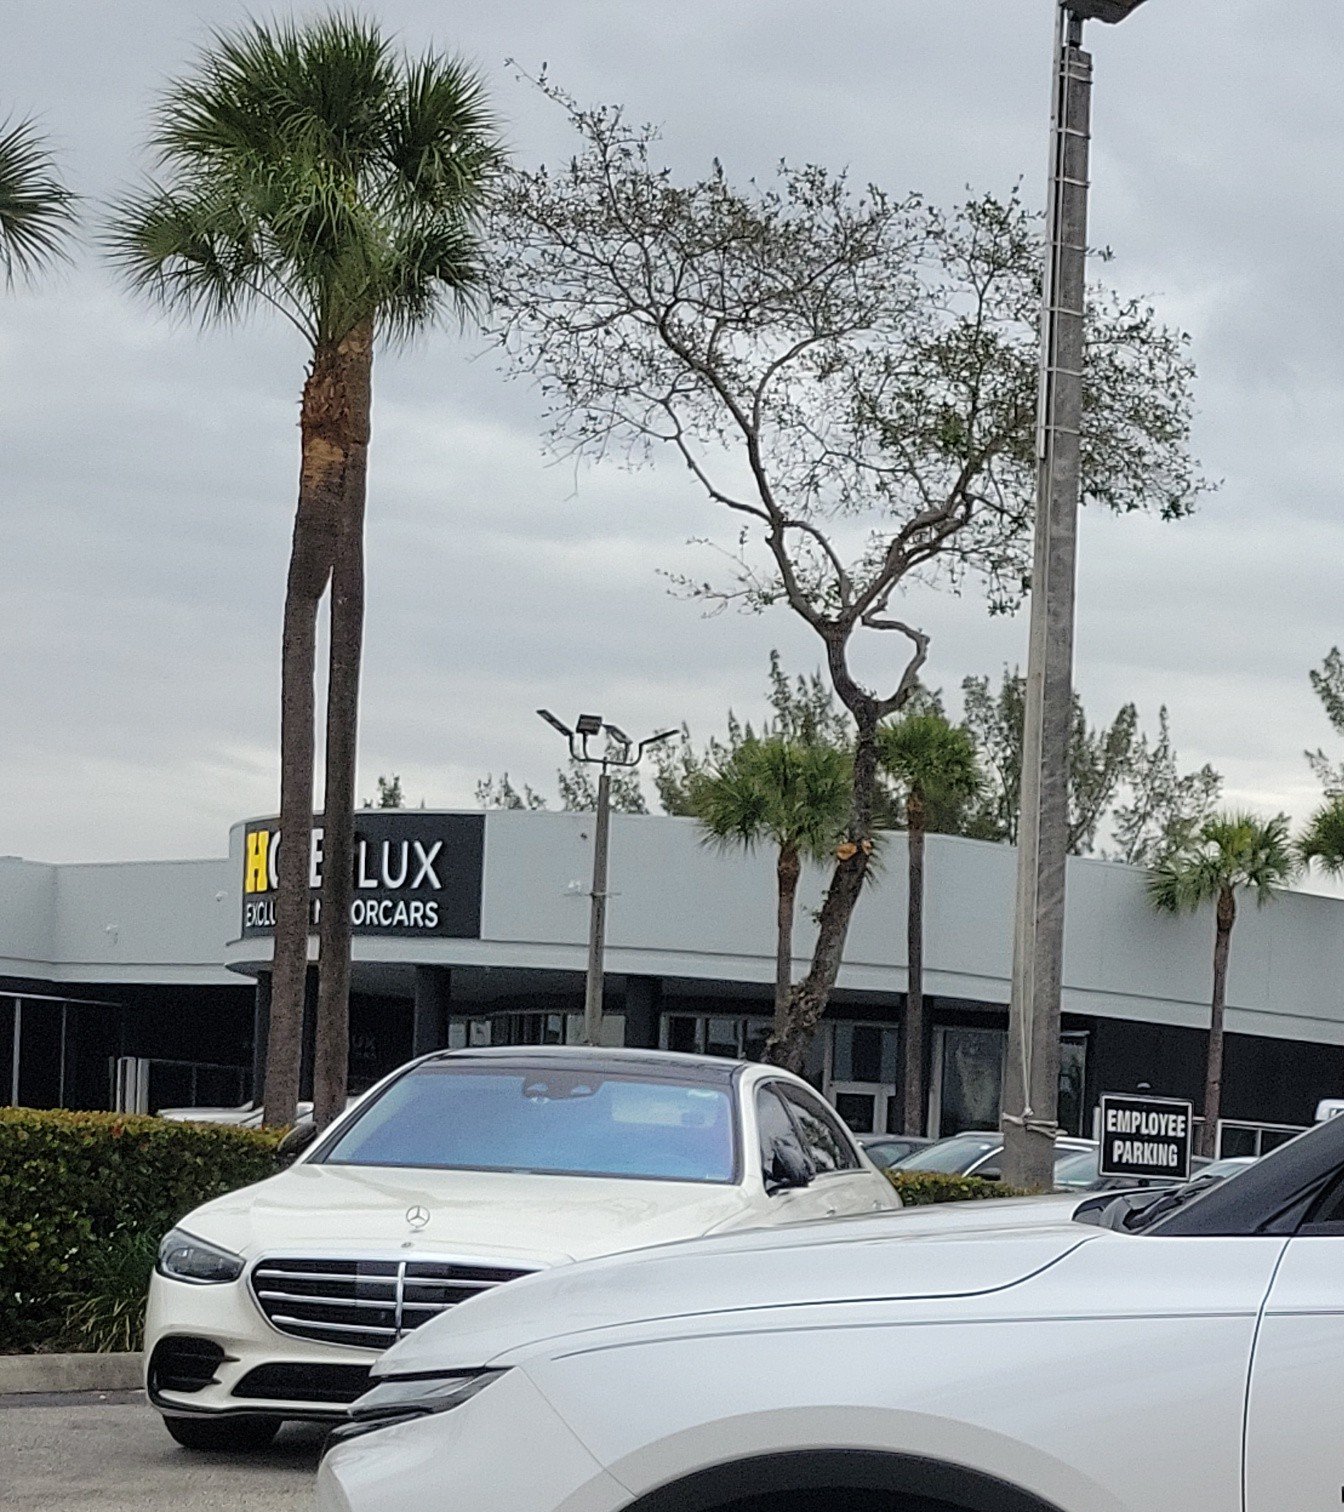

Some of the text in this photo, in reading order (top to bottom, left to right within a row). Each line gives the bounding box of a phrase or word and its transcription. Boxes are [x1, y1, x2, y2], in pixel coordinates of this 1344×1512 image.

[357, 840, 443, 890] LUX
[314, 899, 439, 928] ORCARS
[1106, 1109, 1187, 1138] EMPLOYEE
[1112, 1139, 1178, 1167] PARKING
